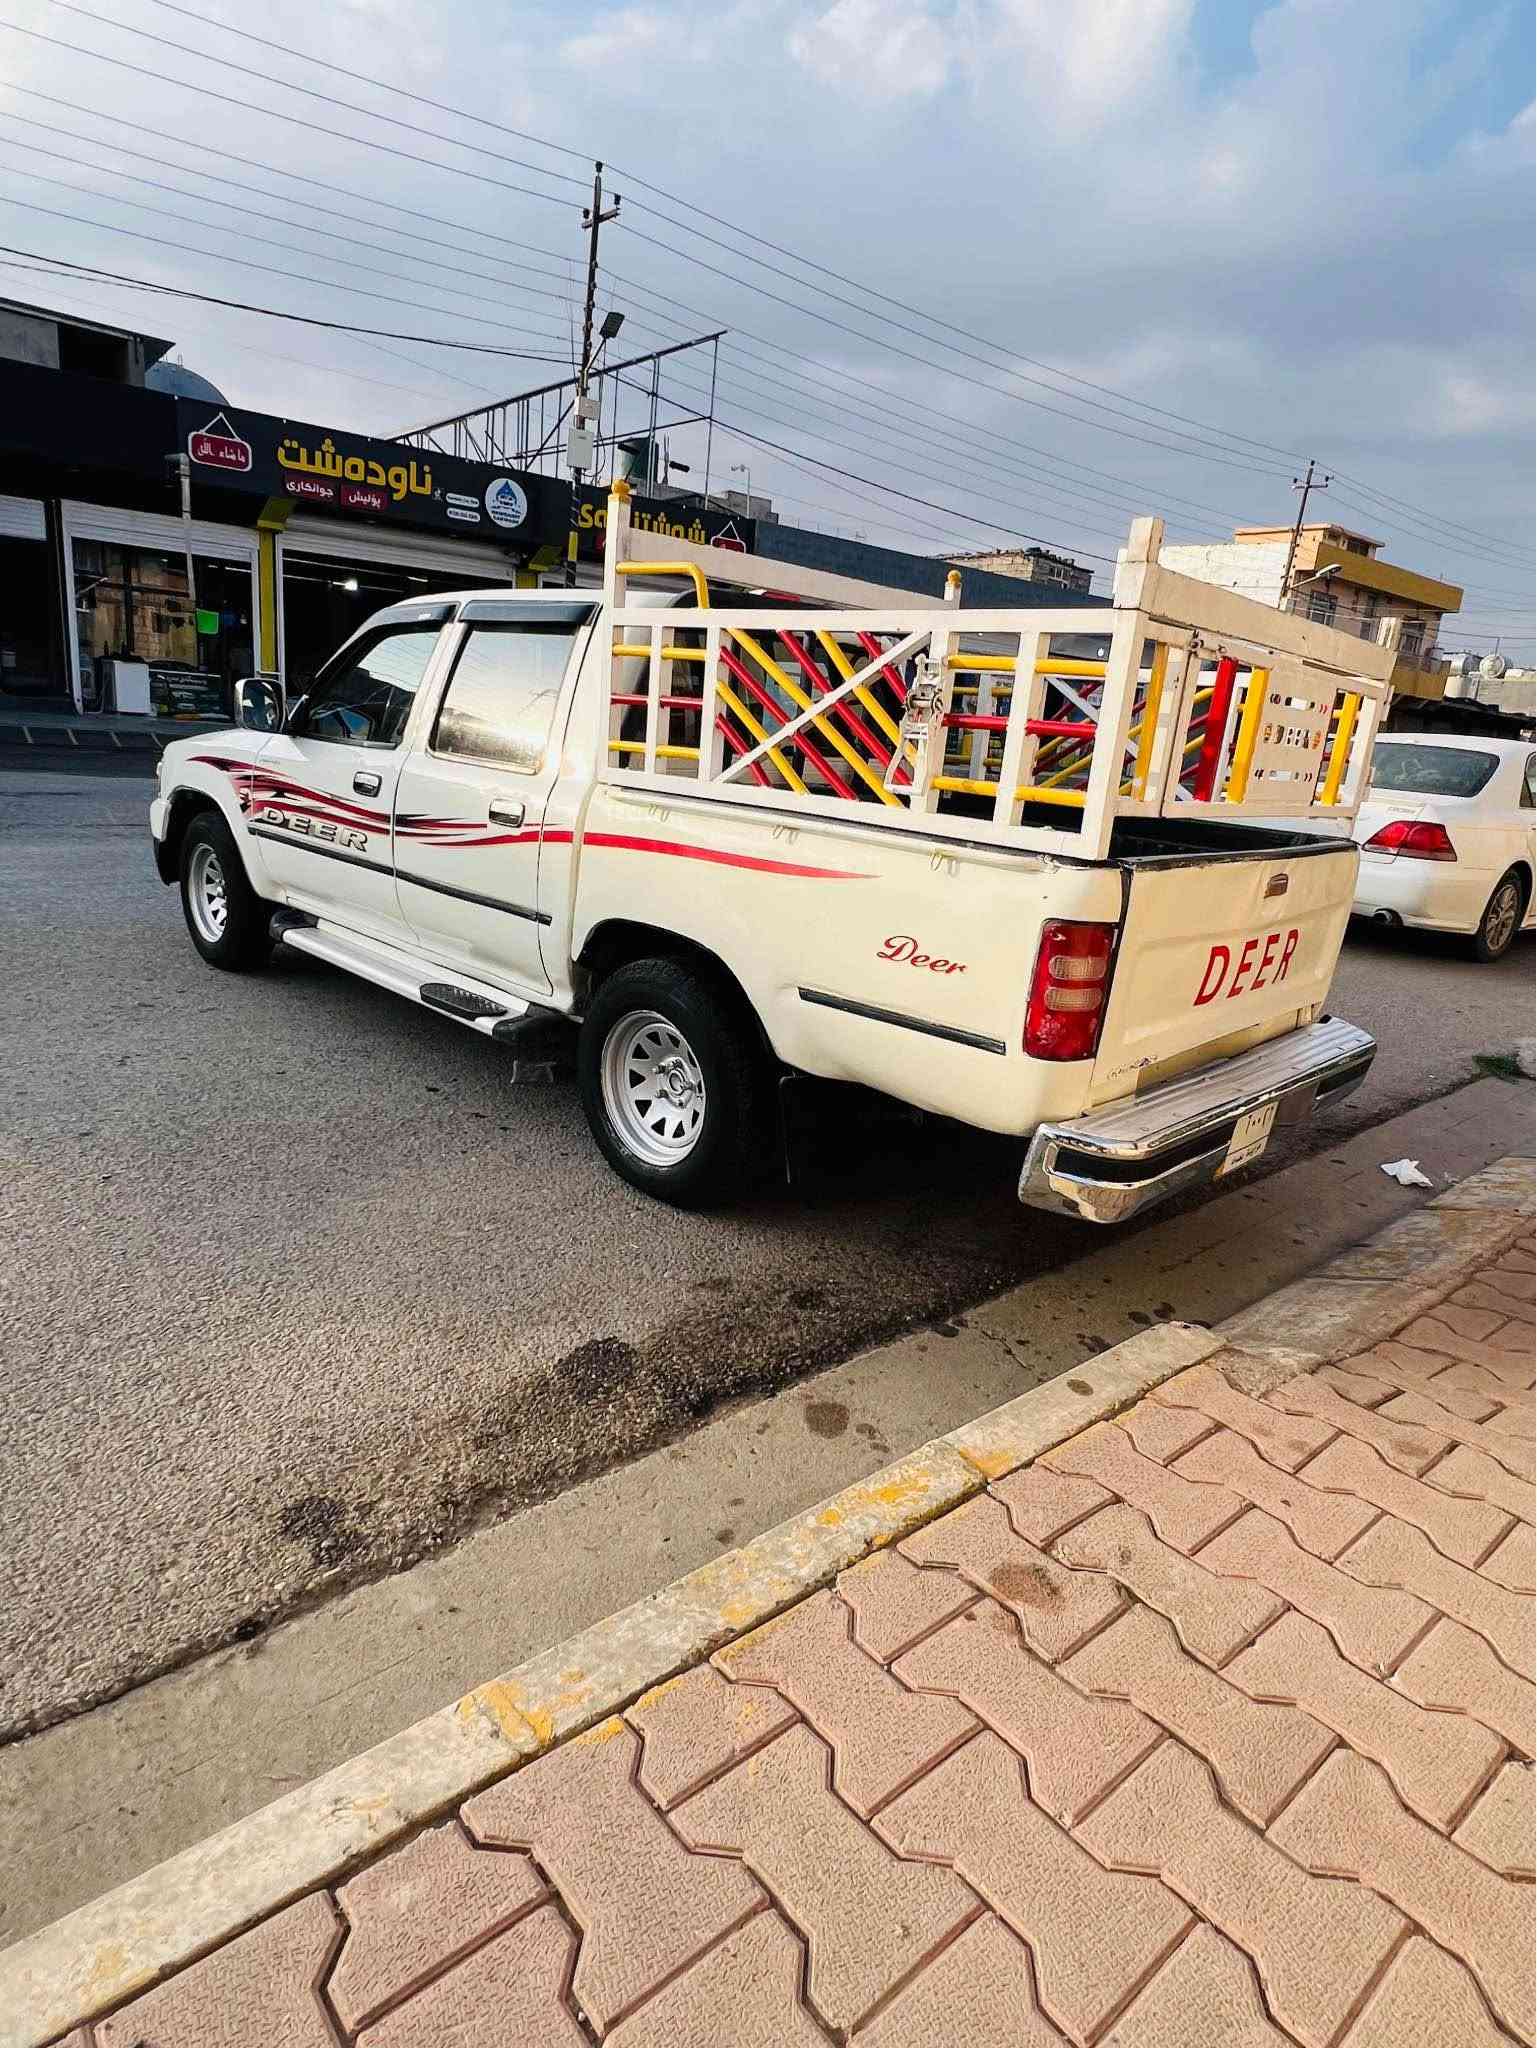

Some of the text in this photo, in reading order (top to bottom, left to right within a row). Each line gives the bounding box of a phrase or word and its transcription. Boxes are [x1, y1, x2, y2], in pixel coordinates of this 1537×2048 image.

[262, 806, 369, 853] DEER
[875, 933, 969, 976] Deer
[1193, 927, 1300, 1007] DEER
